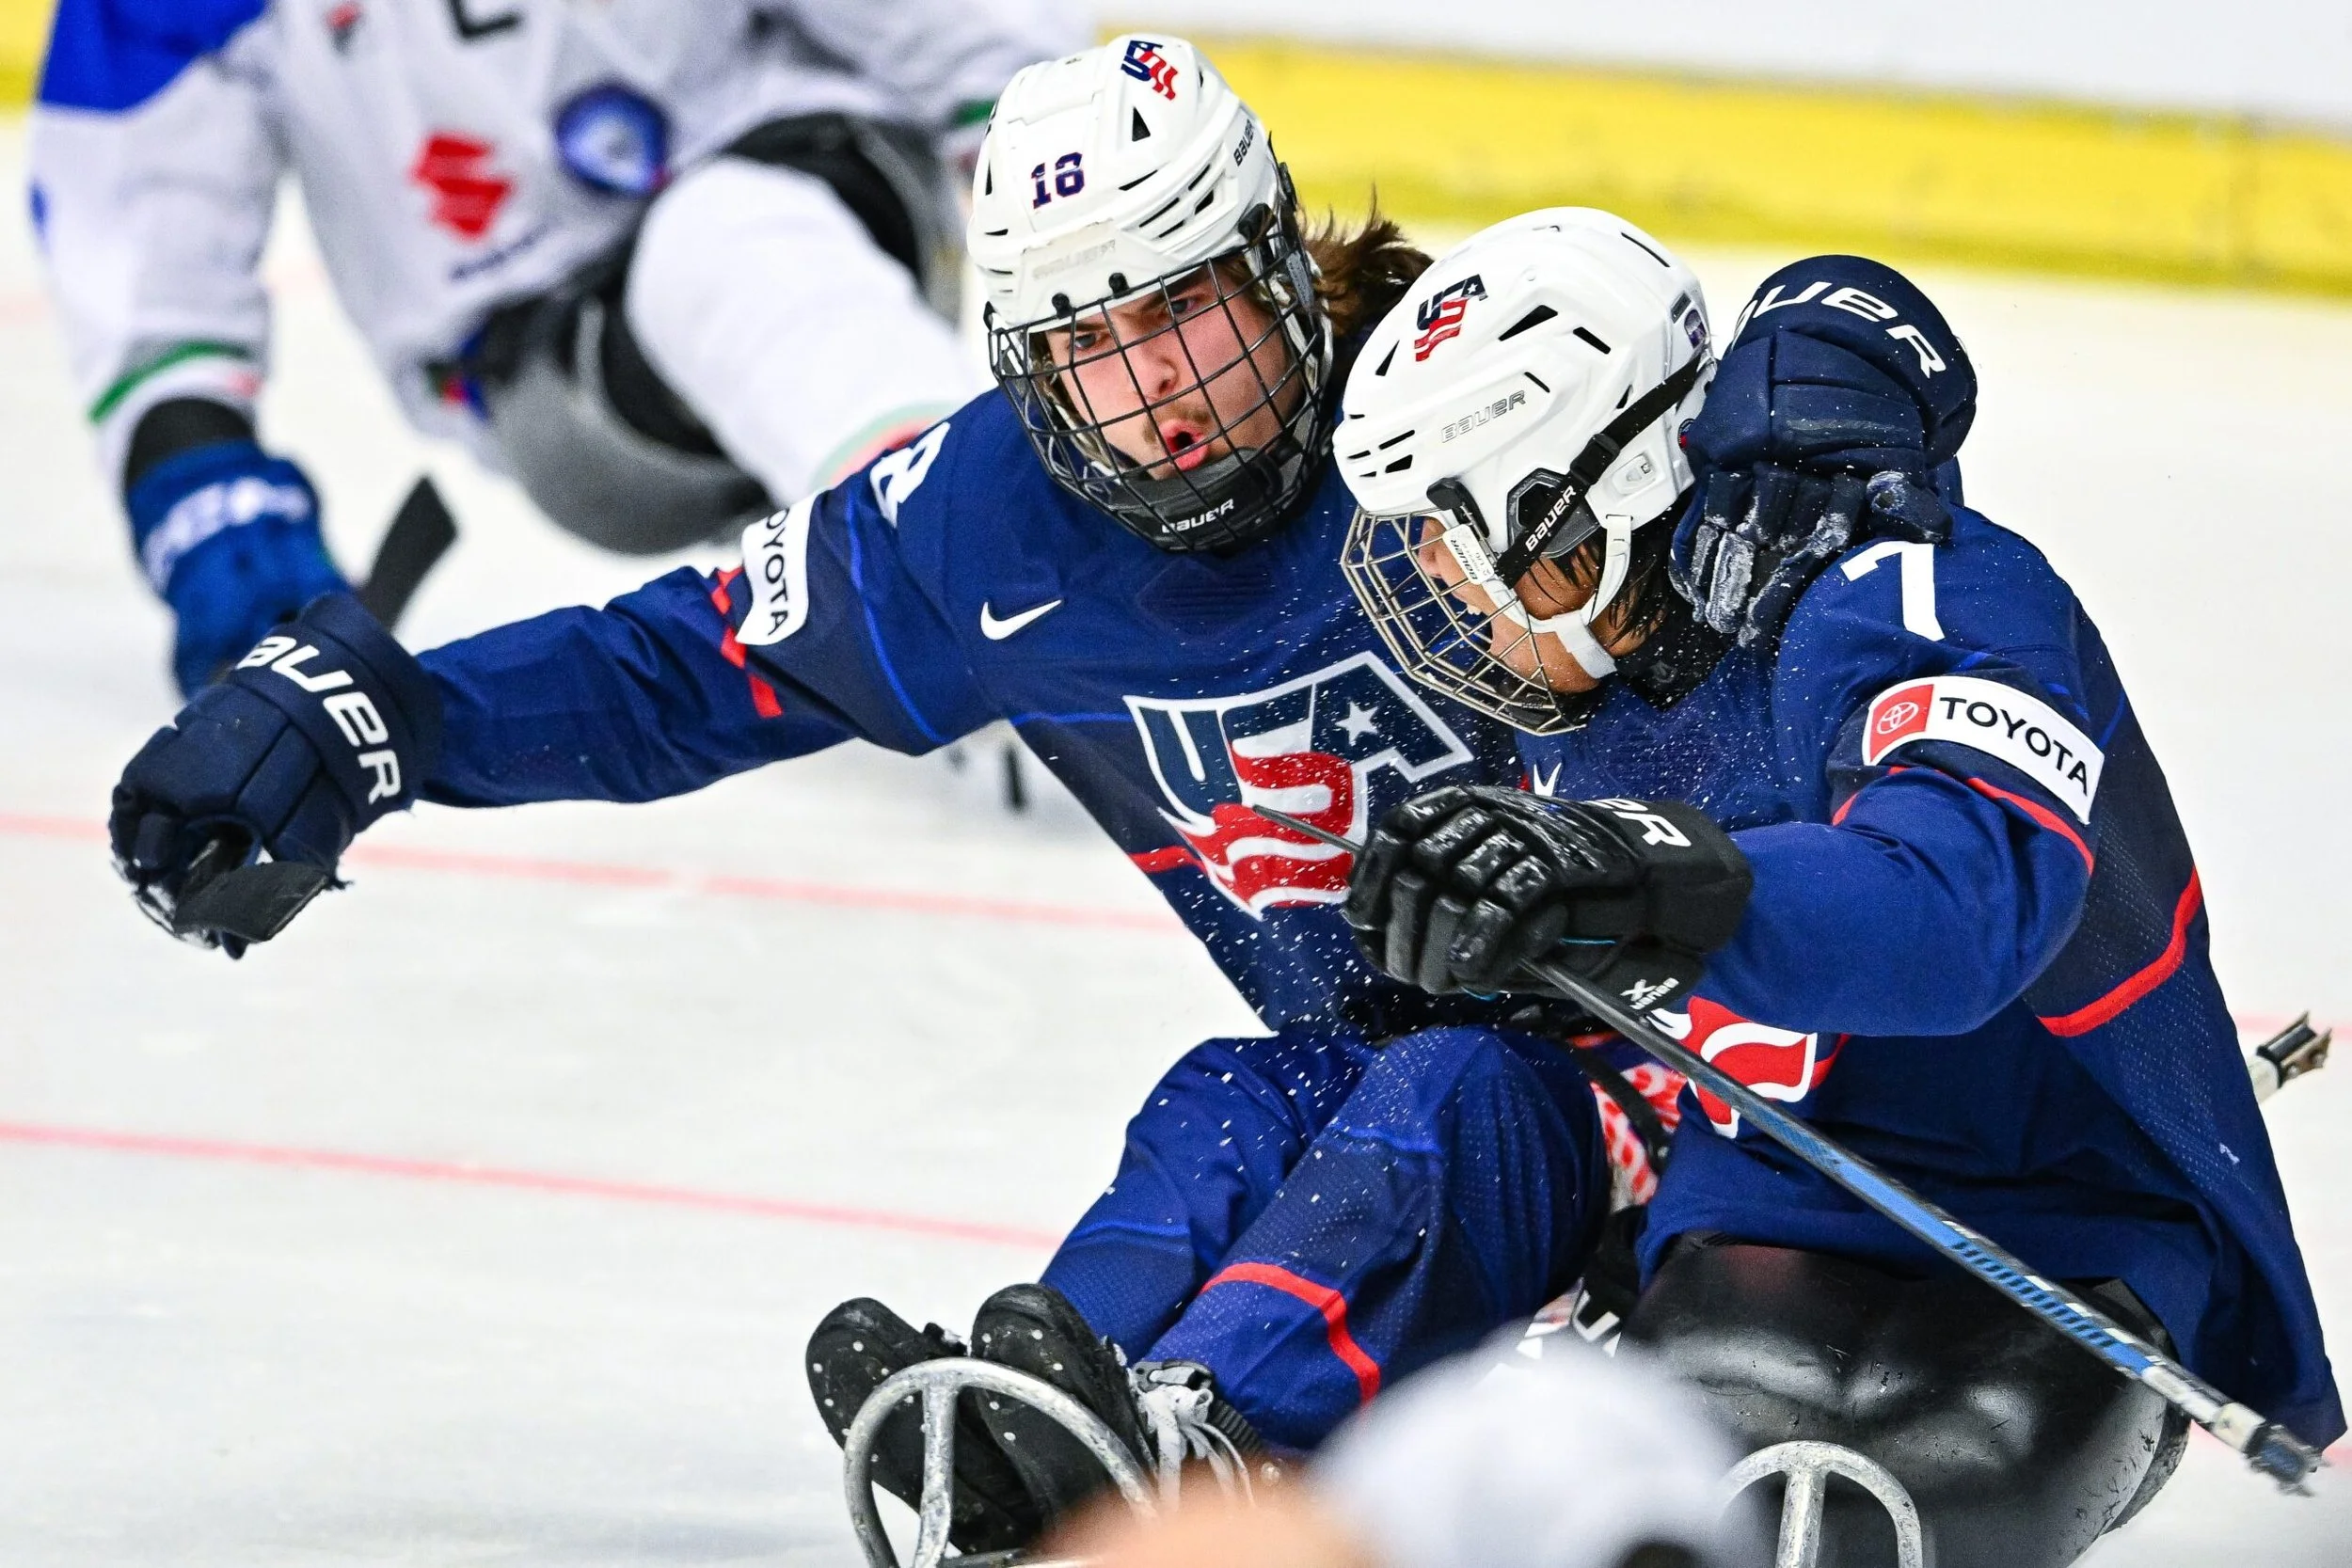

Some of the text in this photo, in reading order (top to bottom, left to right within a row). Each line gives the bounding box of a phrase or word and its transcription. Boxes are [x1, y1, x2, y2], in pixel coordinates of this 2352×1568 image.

[1120, 40, 1178, 101] USA
[1031, 151, 1085, 209] 18
[1233, 119, 1255, 166] BAUER
[1414, 274, 1488, 362] USA
[1440, 389, 1526, 443] BAUER
[1161, 498, 1234, 533] BAUER
[1525, 485, 1577, 552] BAUER
[763, 508, 790, 636] OYOTA
[1840, 540, 1946, 642] 7
[236, 636, 401, 805] AUER
[1939, 697, 2088, 797] TOYOTA
[1122, 651, 1474, 921] USA
